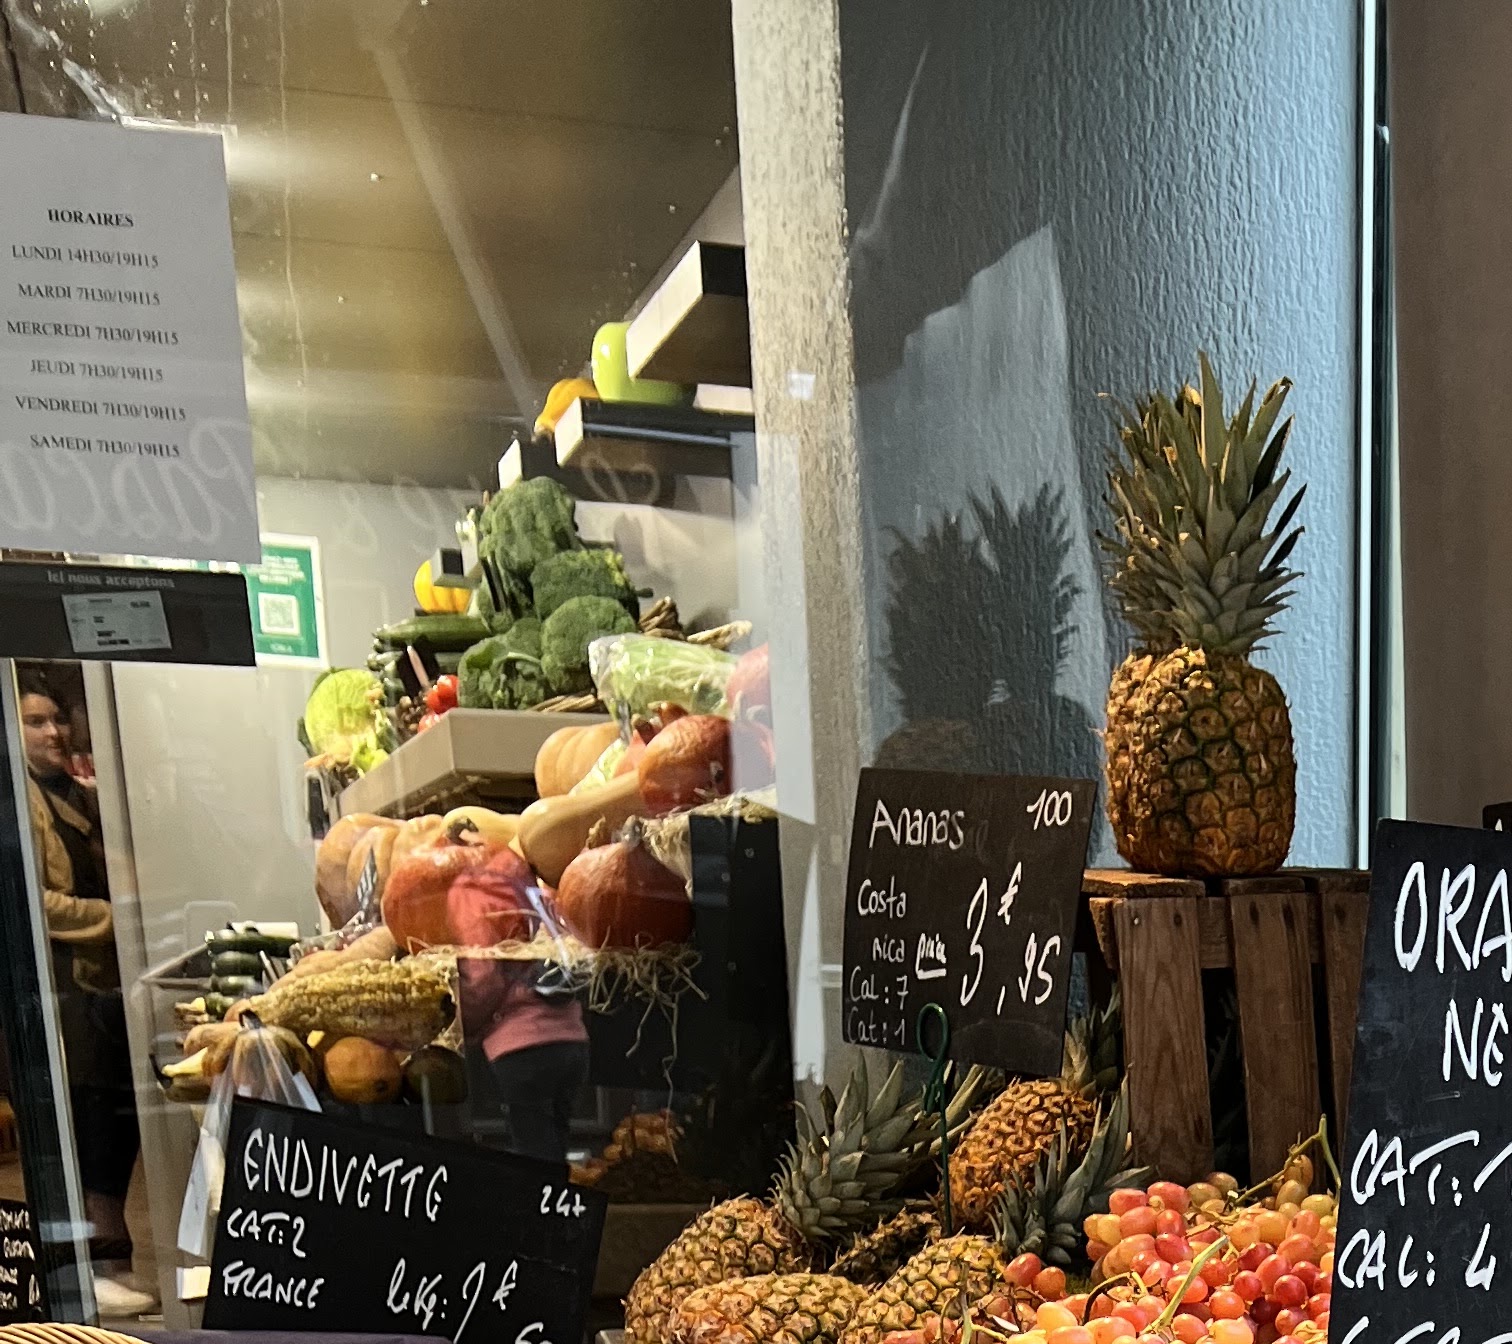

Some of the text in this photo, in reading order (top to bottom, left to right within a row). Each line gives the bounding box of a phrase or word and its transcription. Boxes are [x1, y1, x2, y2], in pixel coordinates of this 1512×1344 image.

[48, 208, 134, 228] HORAIRES
[12, 244, 63, 261] LUNDI
[18, 283, 161, 306] MARDI 7H30/19H15
[7, 320, 179, 345] MERCREDI 7H30/19H15
[30, 359, 164, 382] JEUDI 7H30/19H15
[15, 395, 187, 421] VENDREDI 7H30/19H15
[29, 434, 180, 458] SAMEDI 7H30/19H15
[869, 788, 1073, 850] Ananas 100
[857, 875, 907, 919] Costa
[243, 1127, 448, 1223] ENDIVETTE
[222, 1259, 325, 1310] FRANCE
